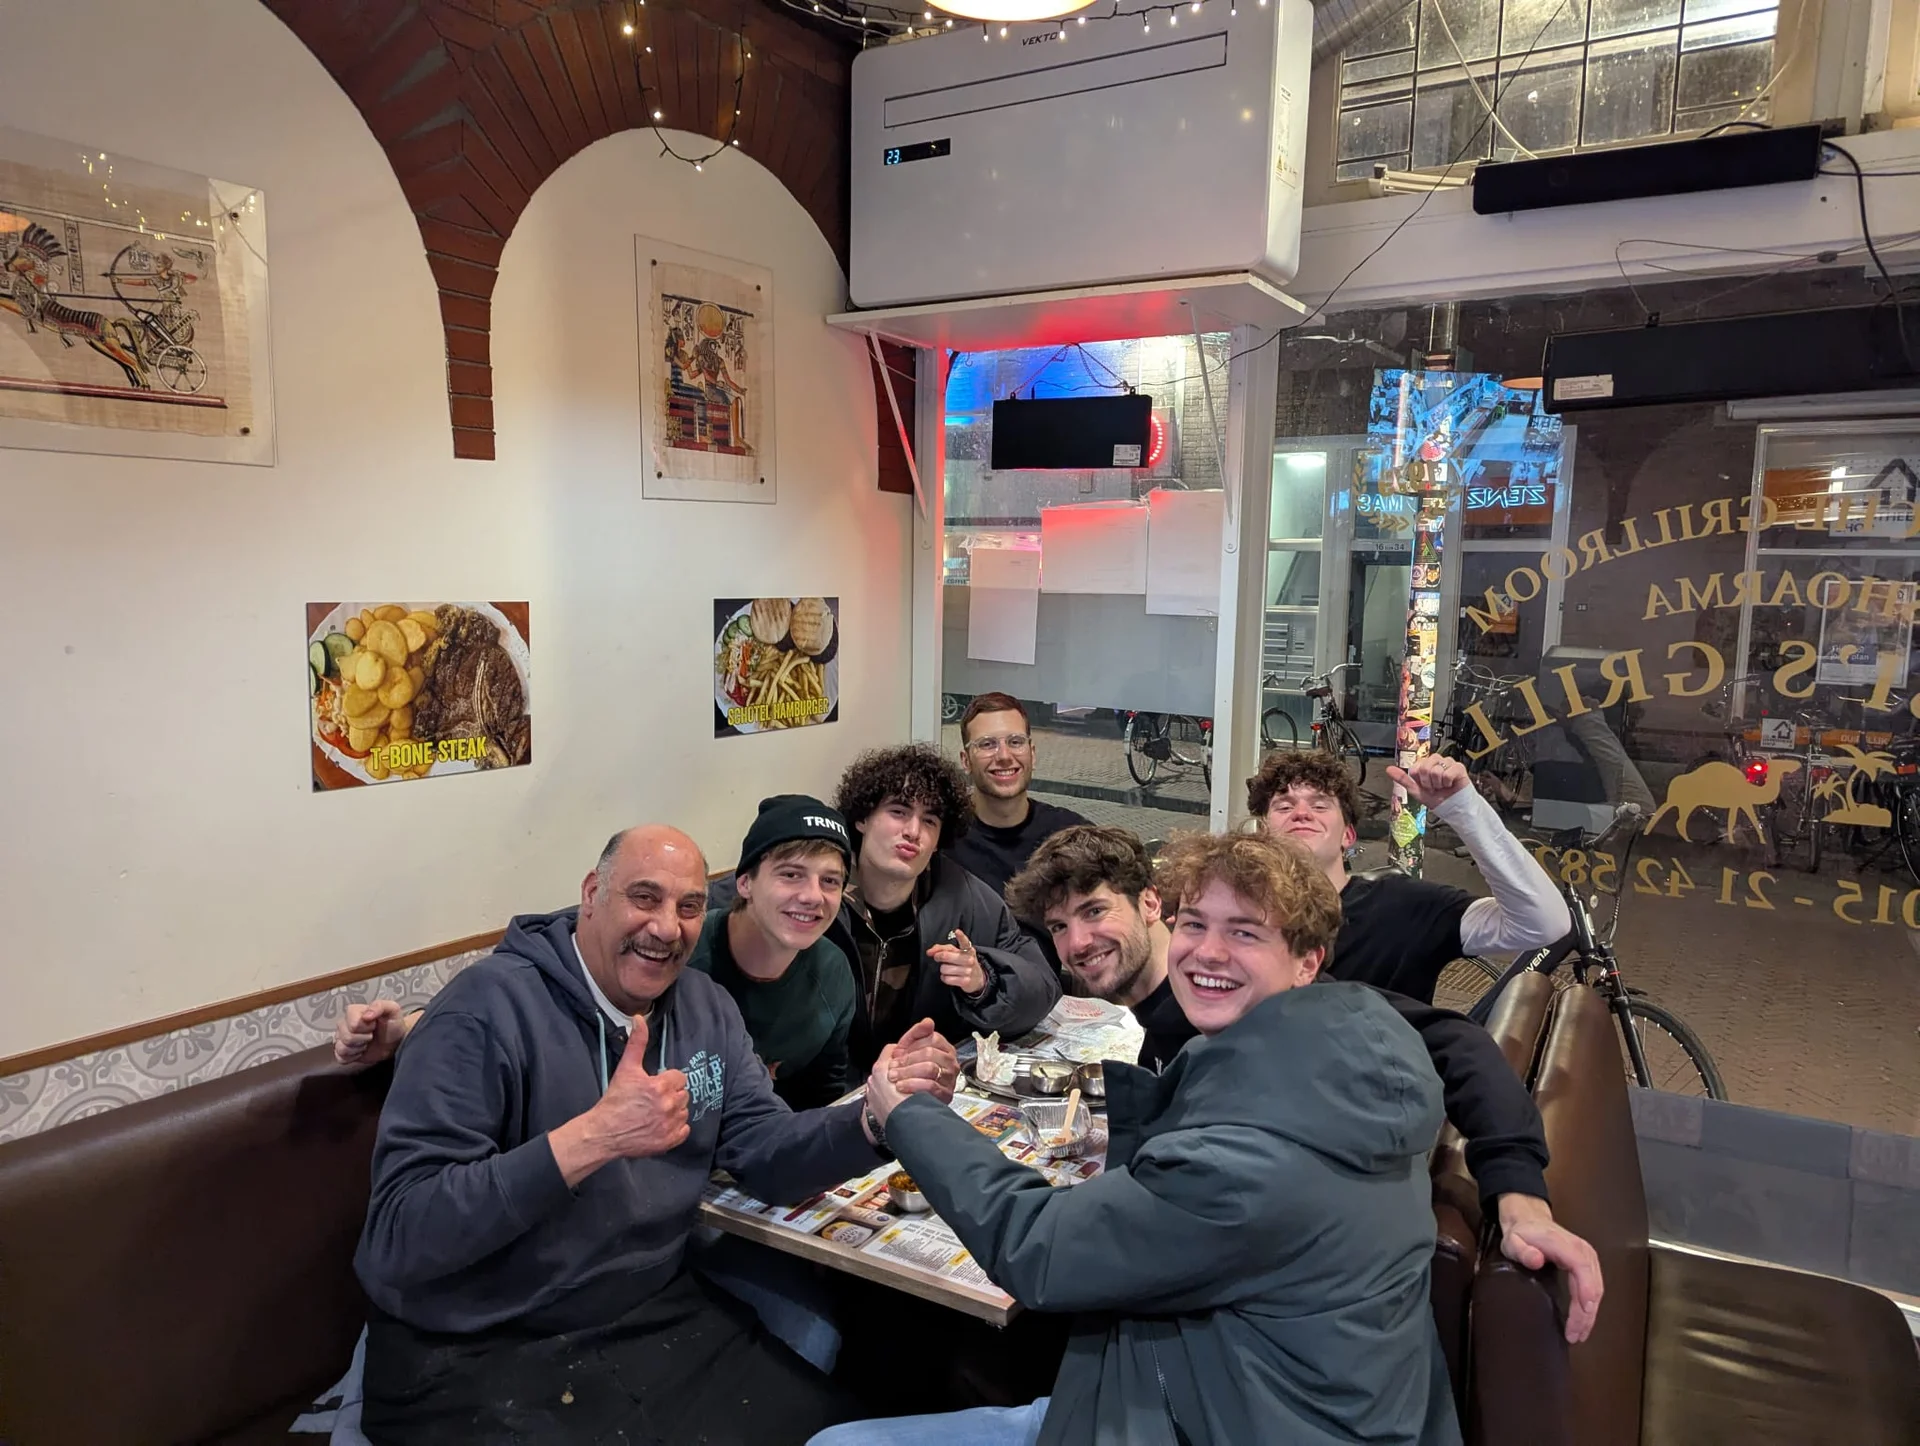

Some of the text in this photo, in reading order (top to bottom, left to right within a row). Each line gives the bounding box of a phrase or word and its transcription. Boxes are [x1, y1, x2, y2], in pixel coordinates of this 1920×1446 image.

[1022, 31, 1059, 46] VEKTO
[886, 149, 900, 165] 23
[727, 698, 829, 726] SCHOTEL HAMBURGER
[370, 736, 488, 771] T-BONE STEAK
